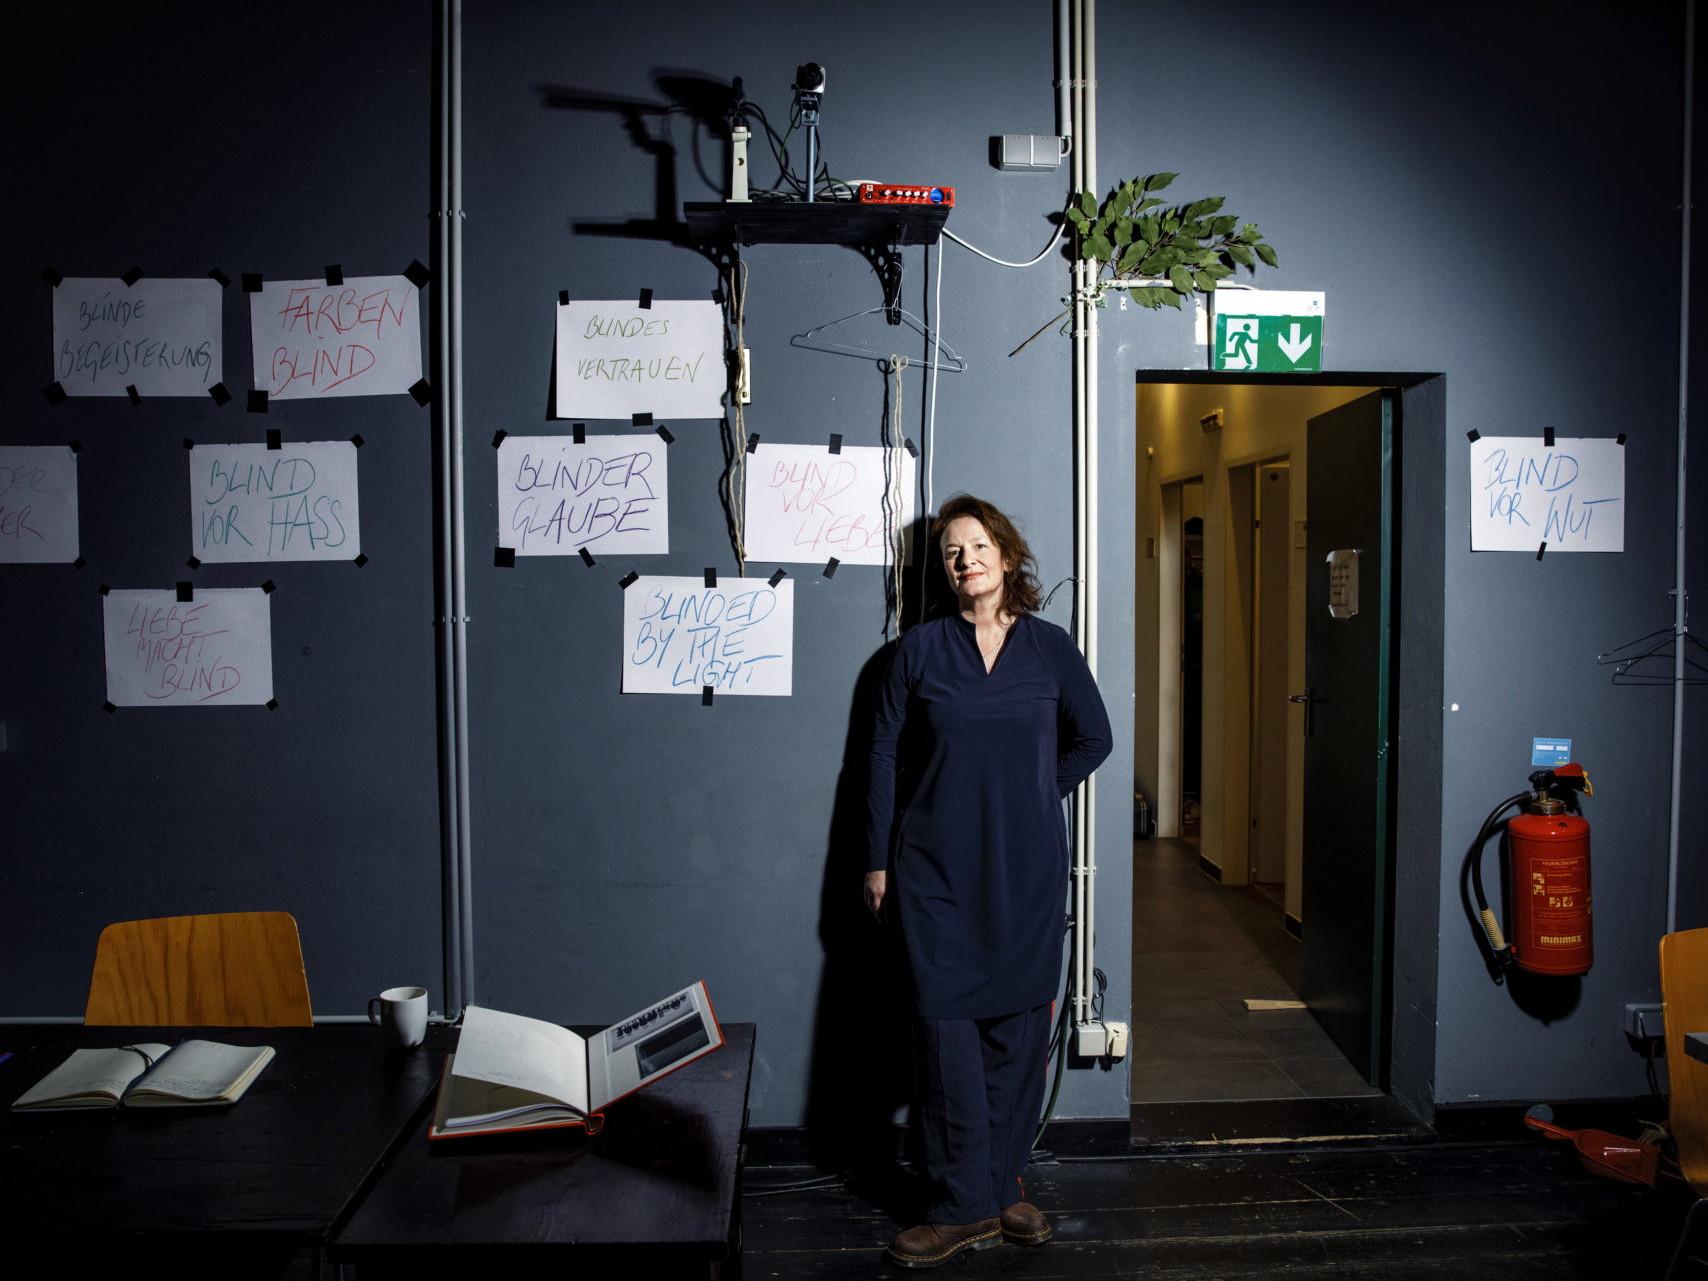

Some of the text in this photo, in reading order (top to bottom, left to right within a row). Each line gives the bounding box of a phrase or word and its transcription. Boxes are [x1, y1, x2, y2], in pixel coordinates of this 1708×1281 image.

[278, 286, 413, 339] FARBEN
[583, 315, 670, 340] BLINDES
[269, 338, 376, 397] BLIND
[577, 352, 705, 383] VERTRAUEN
[206, 458, 316, 504] BLIND
[769, 461, 858, 503] BLIND
[1484, 449, 1579, 492] BLIND
[0, 505, 45, 540] ER
[512, 496, 660, 550] GLAUBE
[782, 487, 836, 517] VOR
[1490, 487, 1620, 542] VOR WUT
[202, 495, 346, 556] VOR HASS
[794, 511, 900, 553] LIEBE
[127, 603, 210, 639] LIEBE
[639, 584, 776, 626] BLINDED
[136, 630, 230, 672] MACHT
[632, 622, 748, 668] BY THE
[145, 657, 241, 702] BLIND
[672, 654, 784, 689] LIGHT
[1541, 935, 1582, 944] minimax
